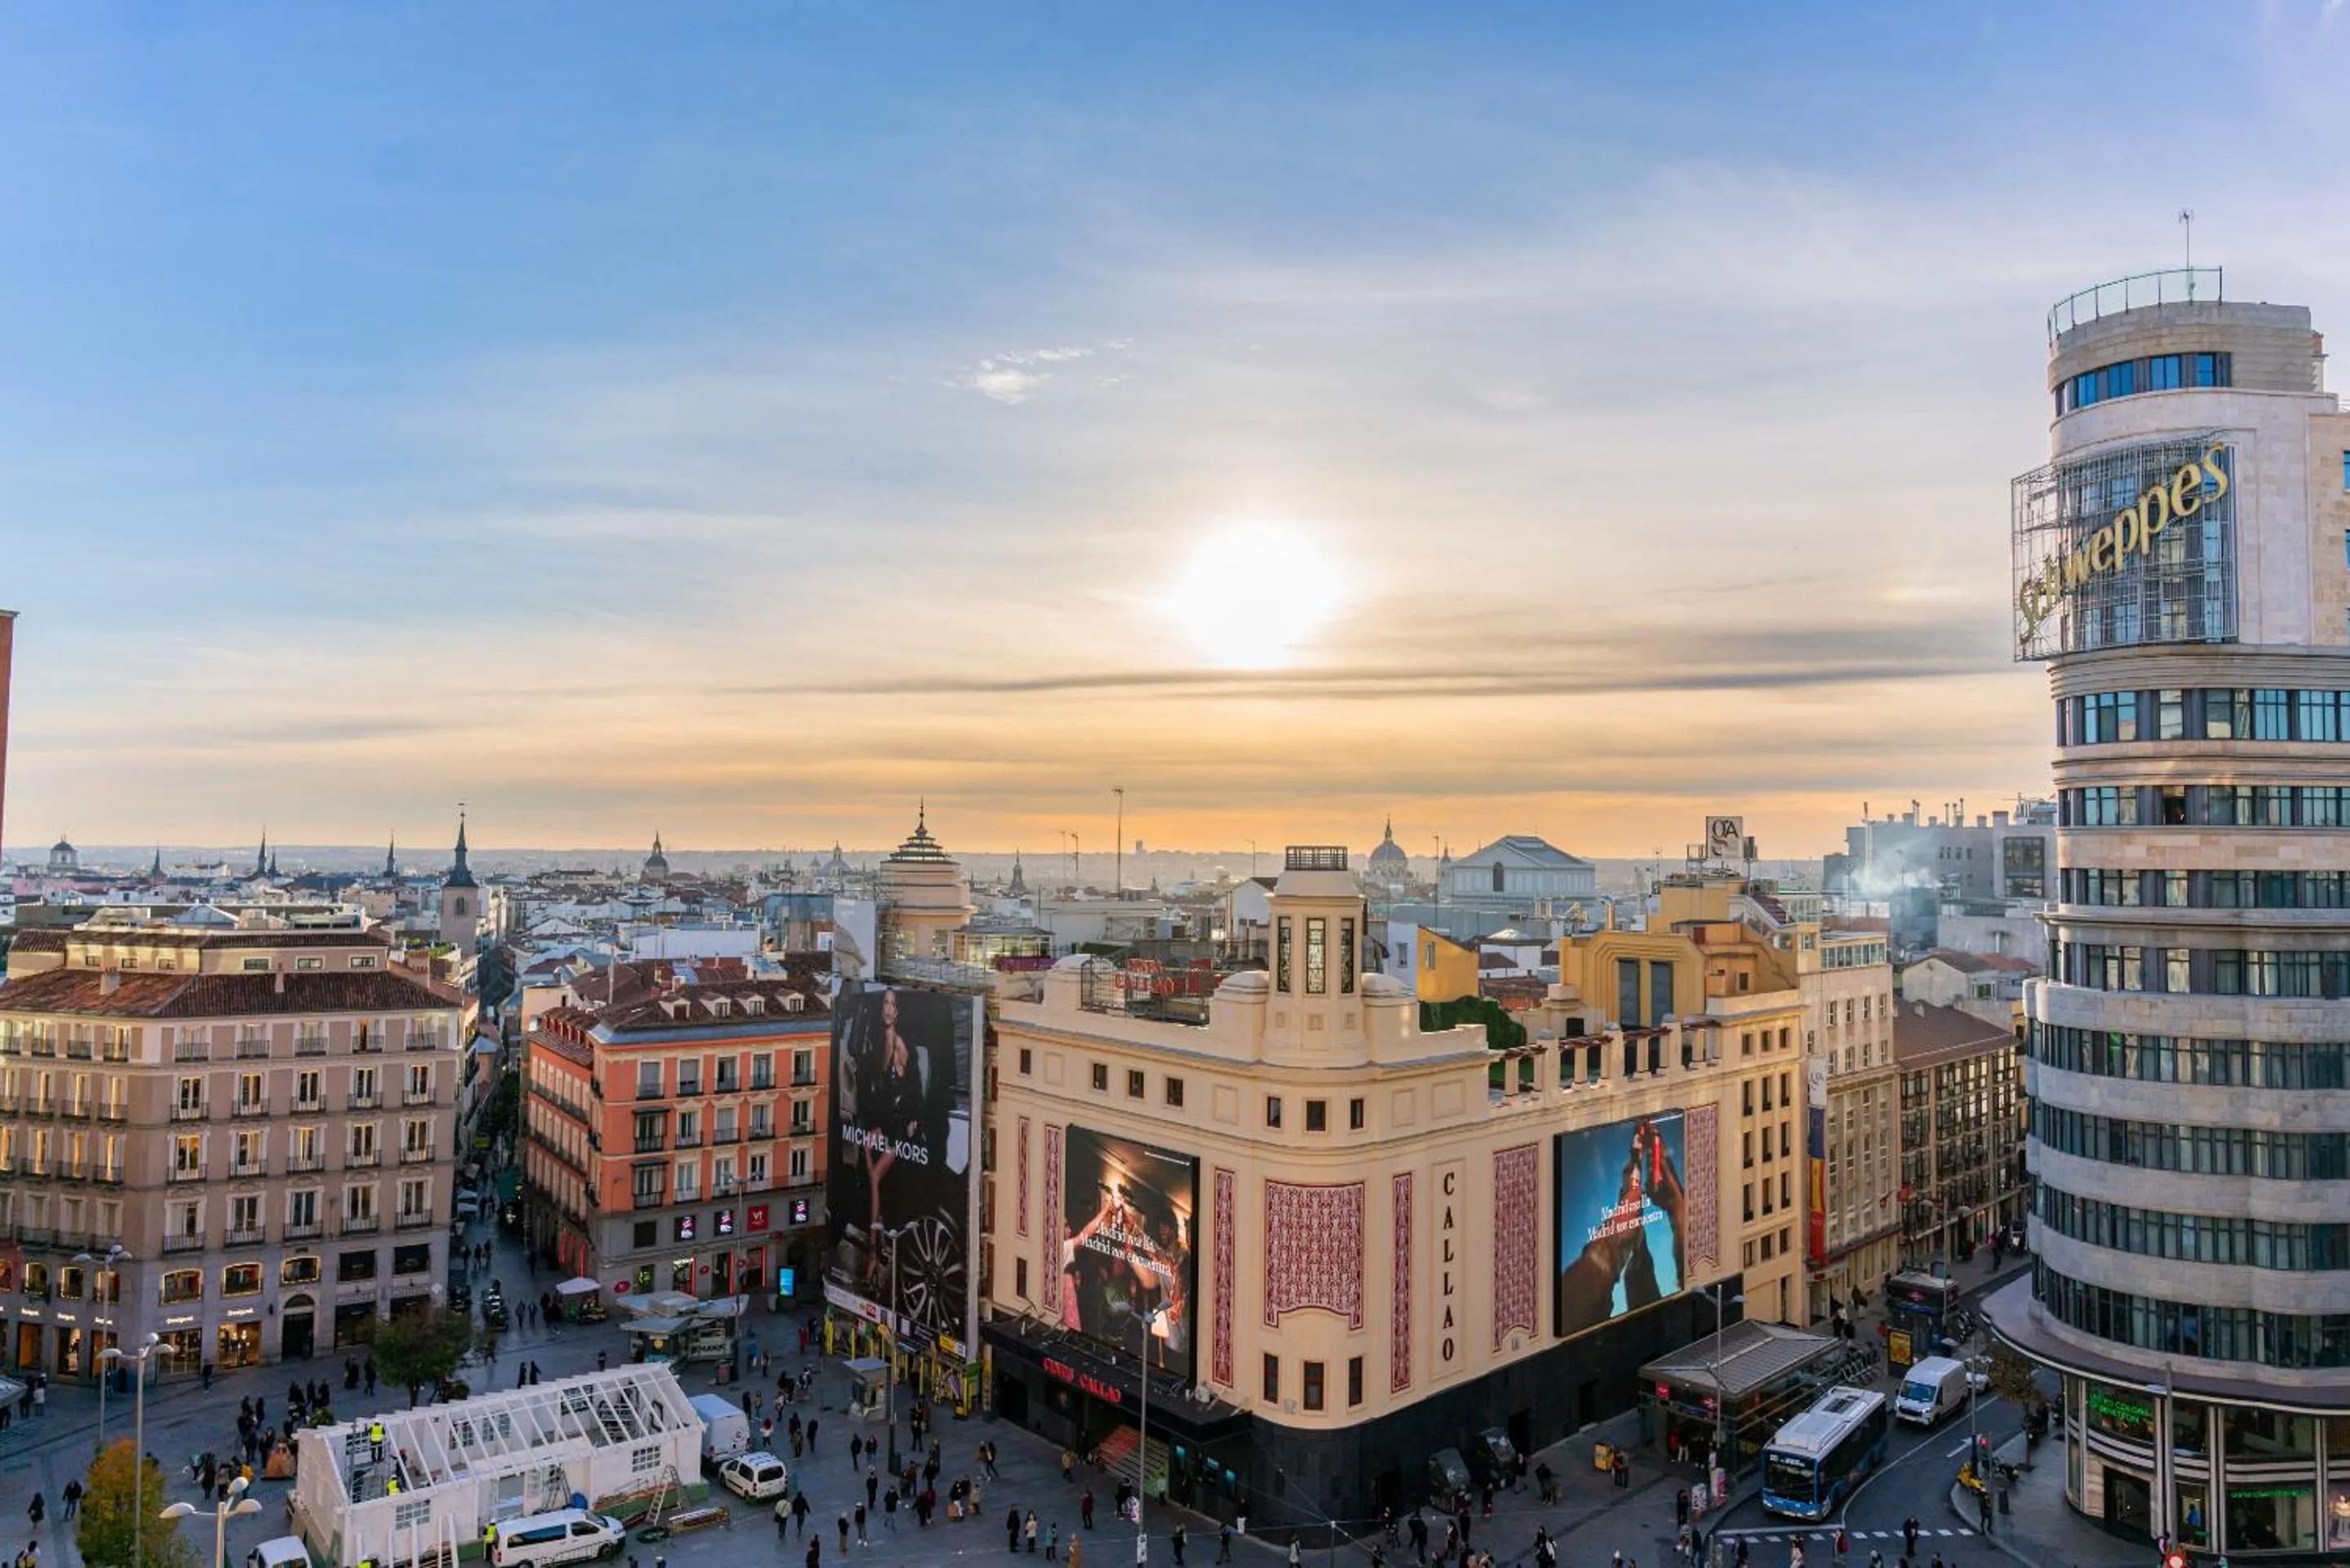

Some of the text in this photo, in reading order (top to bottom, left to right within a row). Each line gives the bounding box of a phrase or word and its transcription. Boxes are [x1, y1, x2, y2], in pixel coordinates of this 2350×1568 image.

[842, 1123, 929, 1165] MICHAEL KORS
[1442, 1172, 1455, 1362] CALLAO
